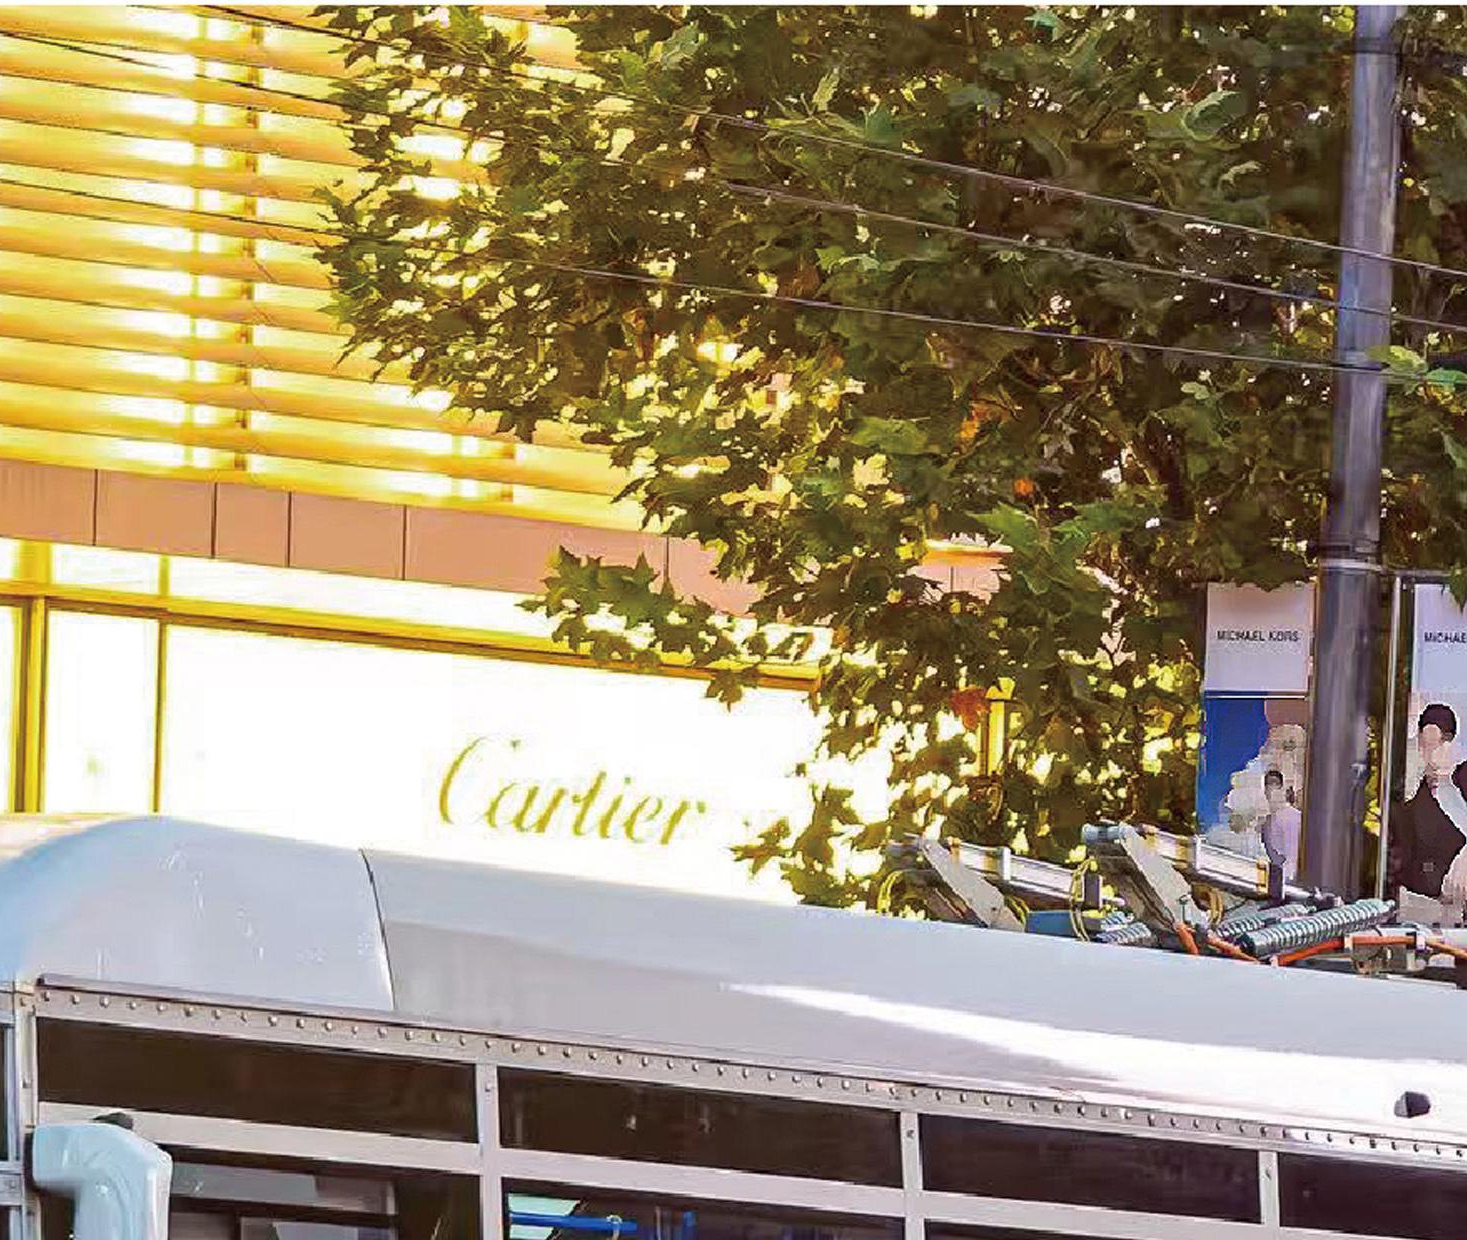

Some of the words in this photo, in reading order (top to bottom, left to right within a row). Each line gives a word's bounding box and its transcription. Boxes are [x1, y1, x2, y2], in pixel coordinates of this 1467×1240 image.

[1218, 630, 1265, 642] MICHAEL
[1269, 630, 1299, 642] KORS
[438, 736, 707, 846] Cartier
